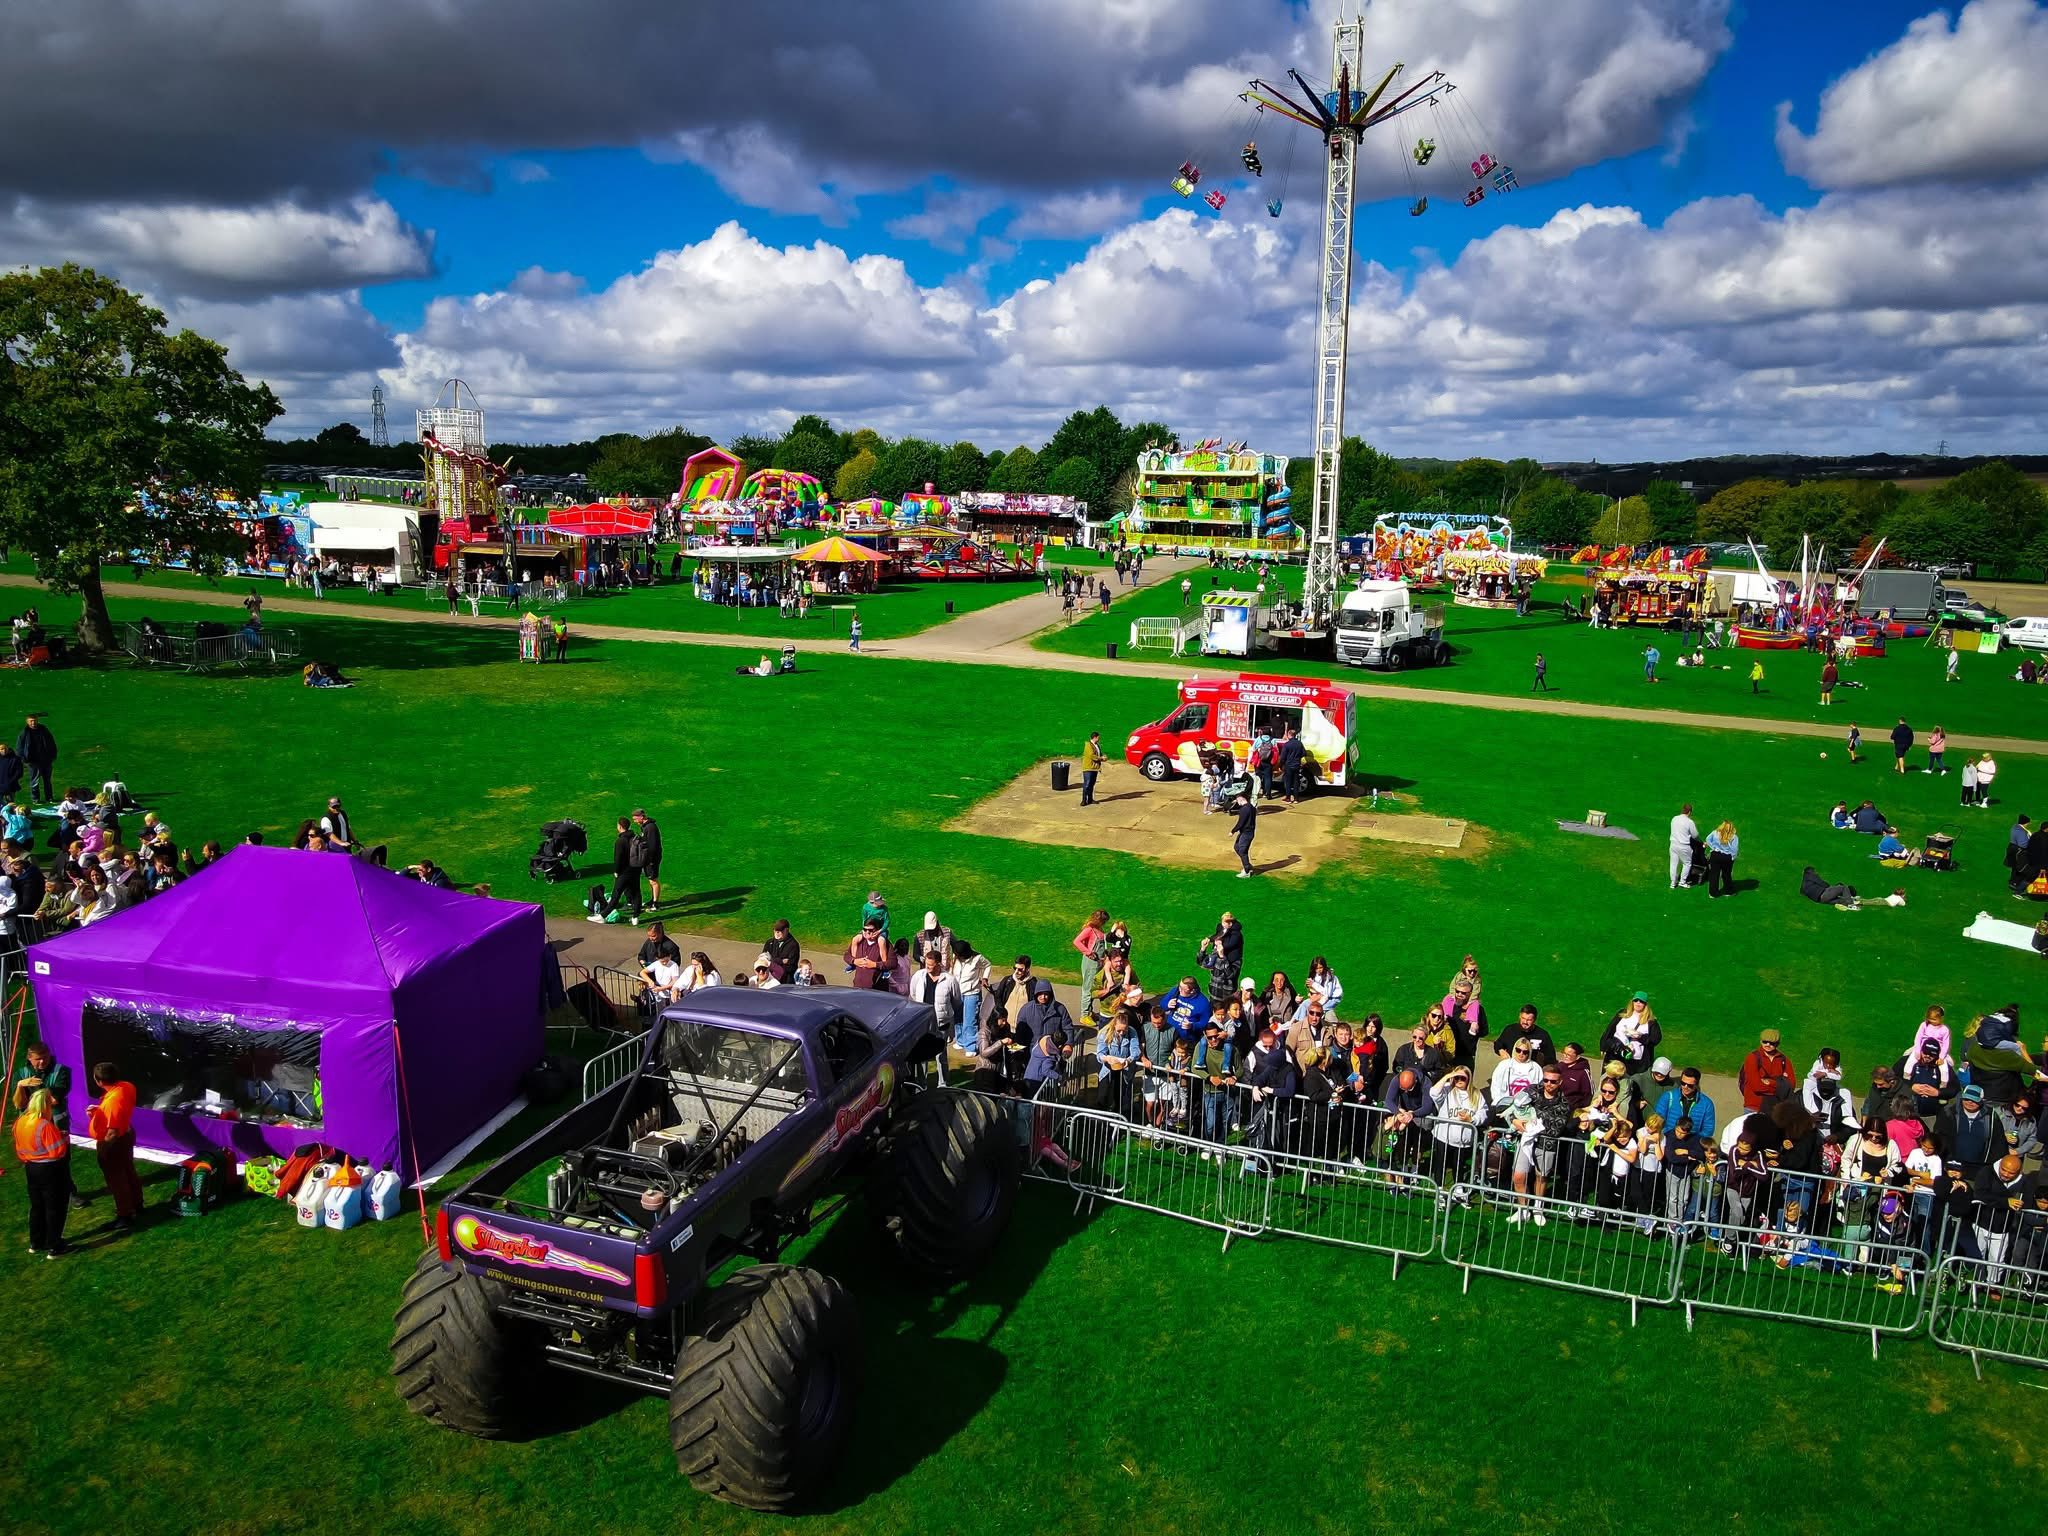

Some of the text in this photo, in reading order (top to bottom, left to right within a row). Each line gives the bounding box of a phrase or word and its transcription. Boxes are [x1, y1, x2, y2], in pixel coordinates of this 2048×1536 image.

[1399, 512, 1489, 523] RUNAWAY TRAIN
[1238, 683, 1311, 696] ICE COLD DRINKS
[472, 1226, 549, 1261] Slingshot
[486, 1268, 604, 1303] www.slingshotmt.co.uk
